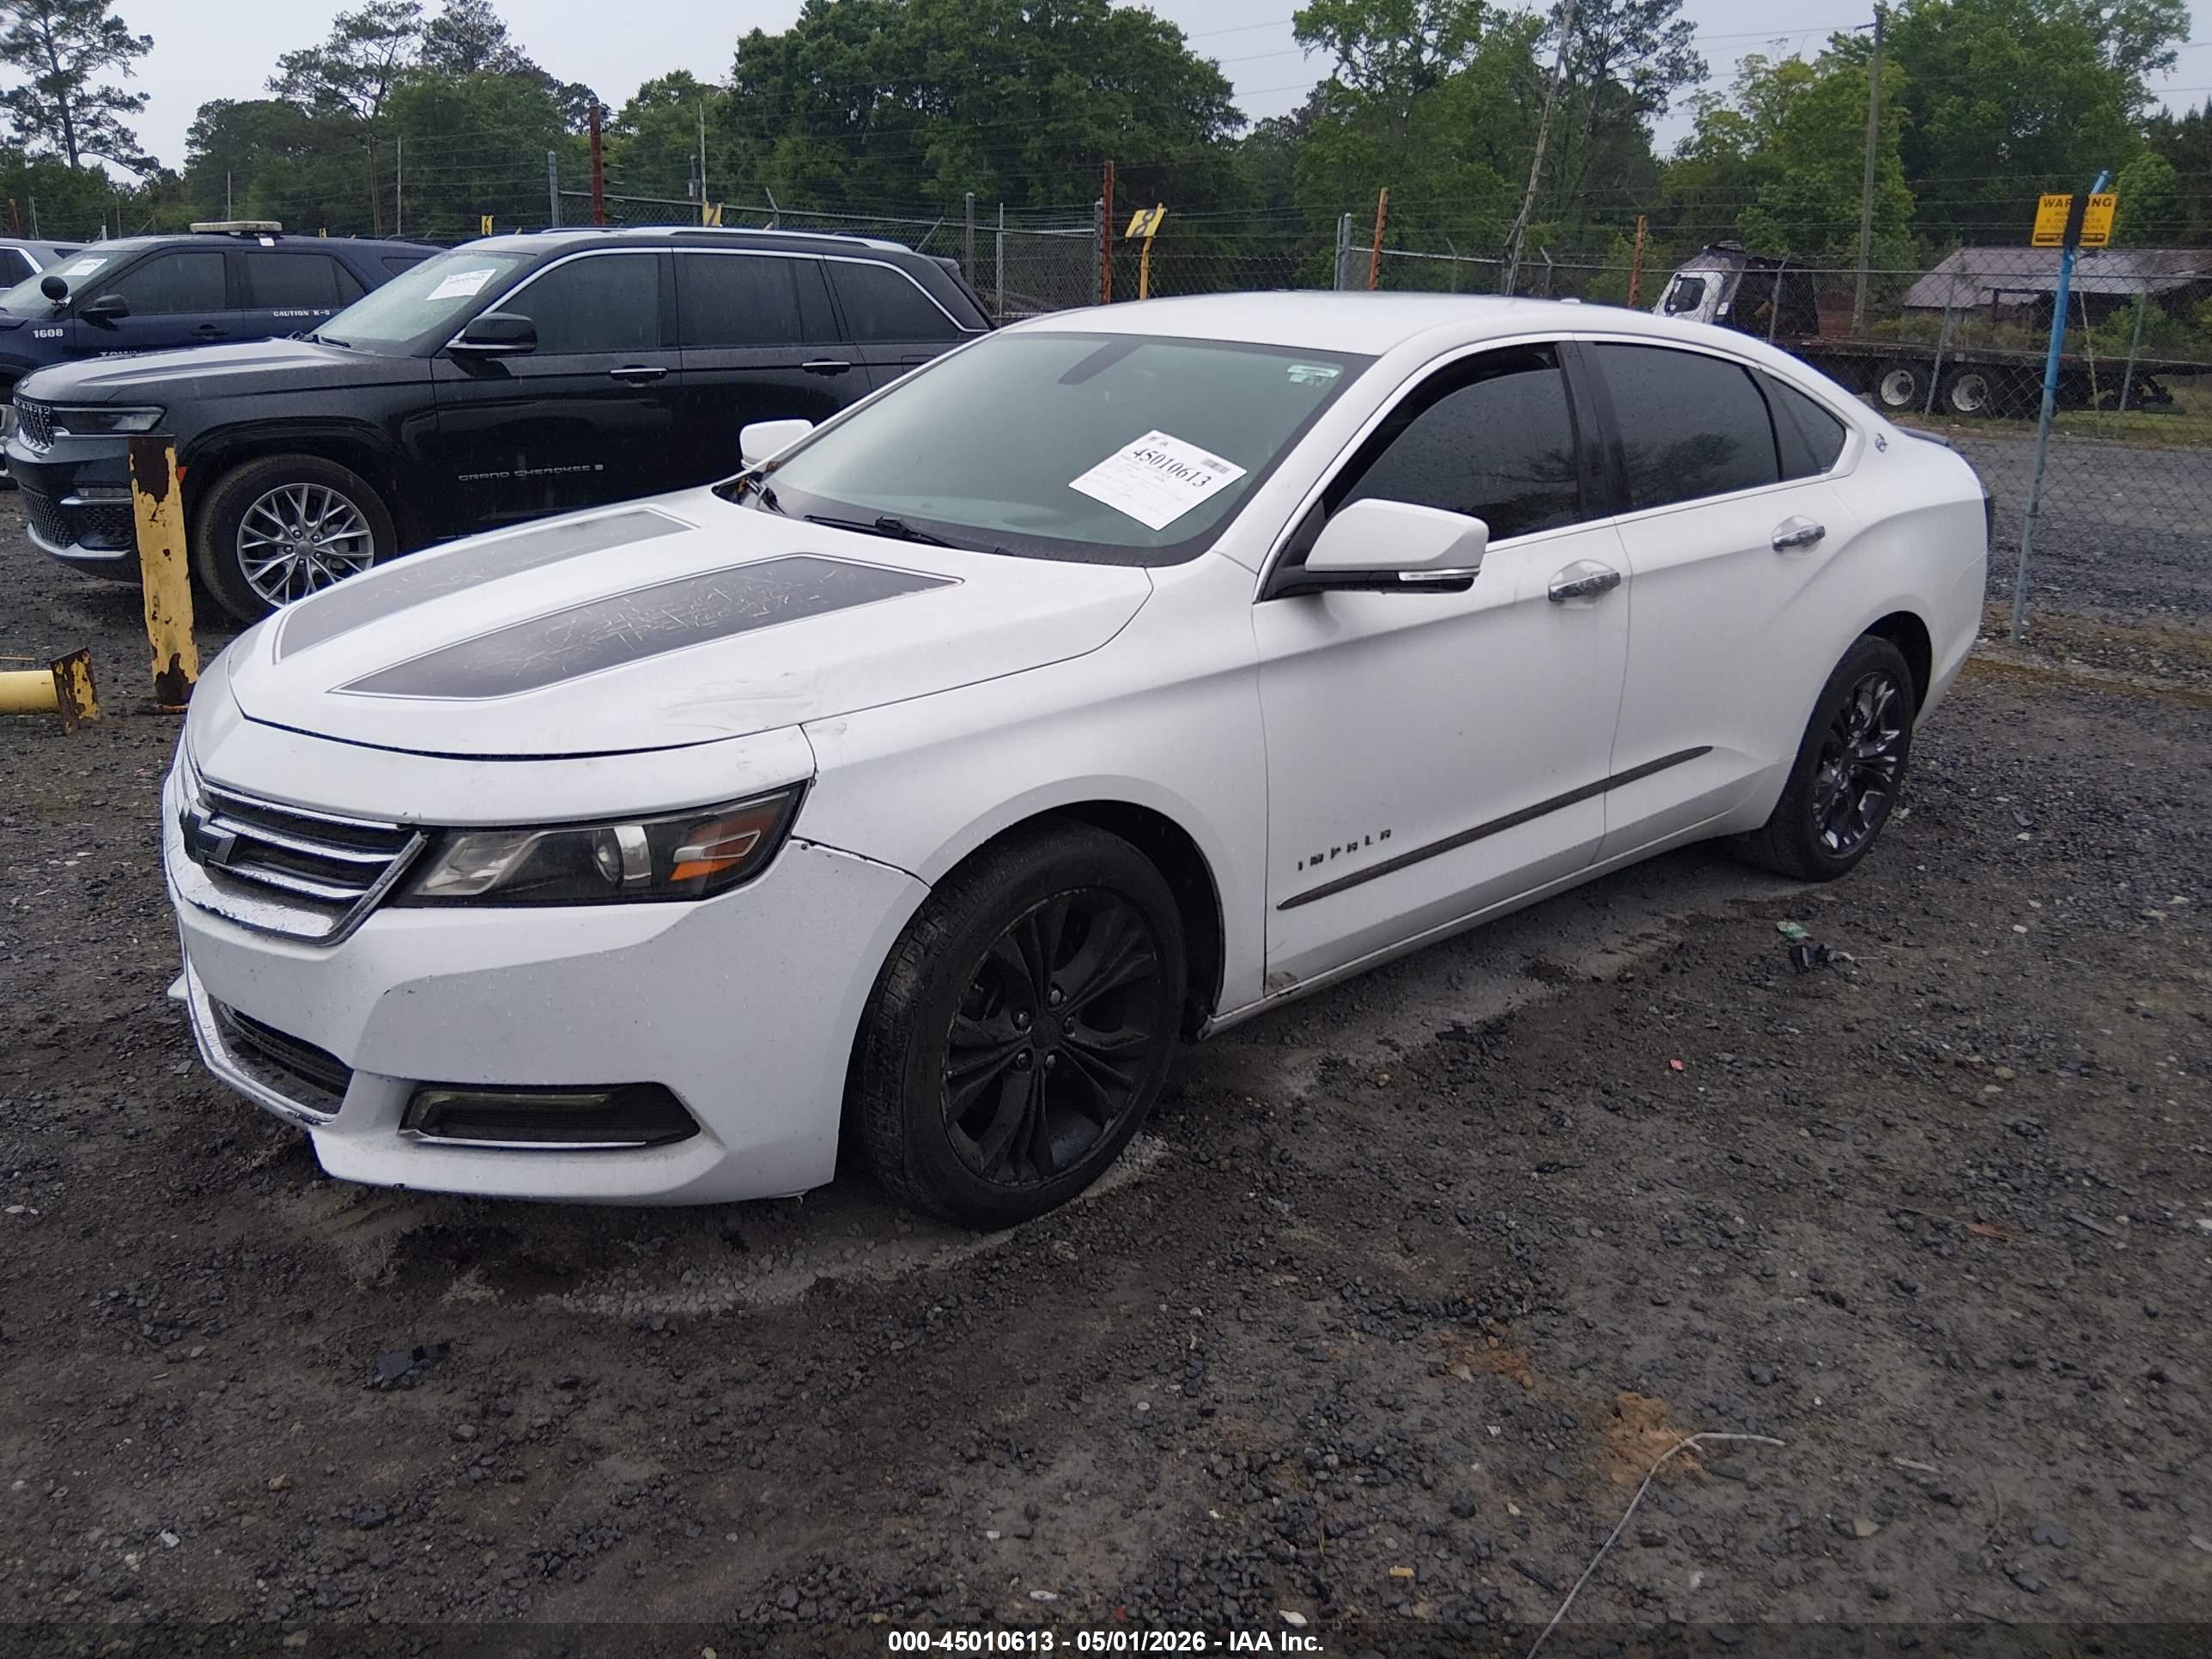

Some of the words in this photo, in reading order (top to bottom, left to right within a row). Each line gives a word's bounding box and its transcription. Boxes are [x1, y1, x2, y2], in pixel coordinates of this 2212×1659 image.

[1131, 210, 1154, 237] 8
[33, 328, 64, 338] 1608
[458, 471, 510, 481] GRAND
[514, 465, 592, 477] CHEROKEE
[1133, 447, 1212, 489] 45010613
[1297, 829, 1392, 872] IMPALA
